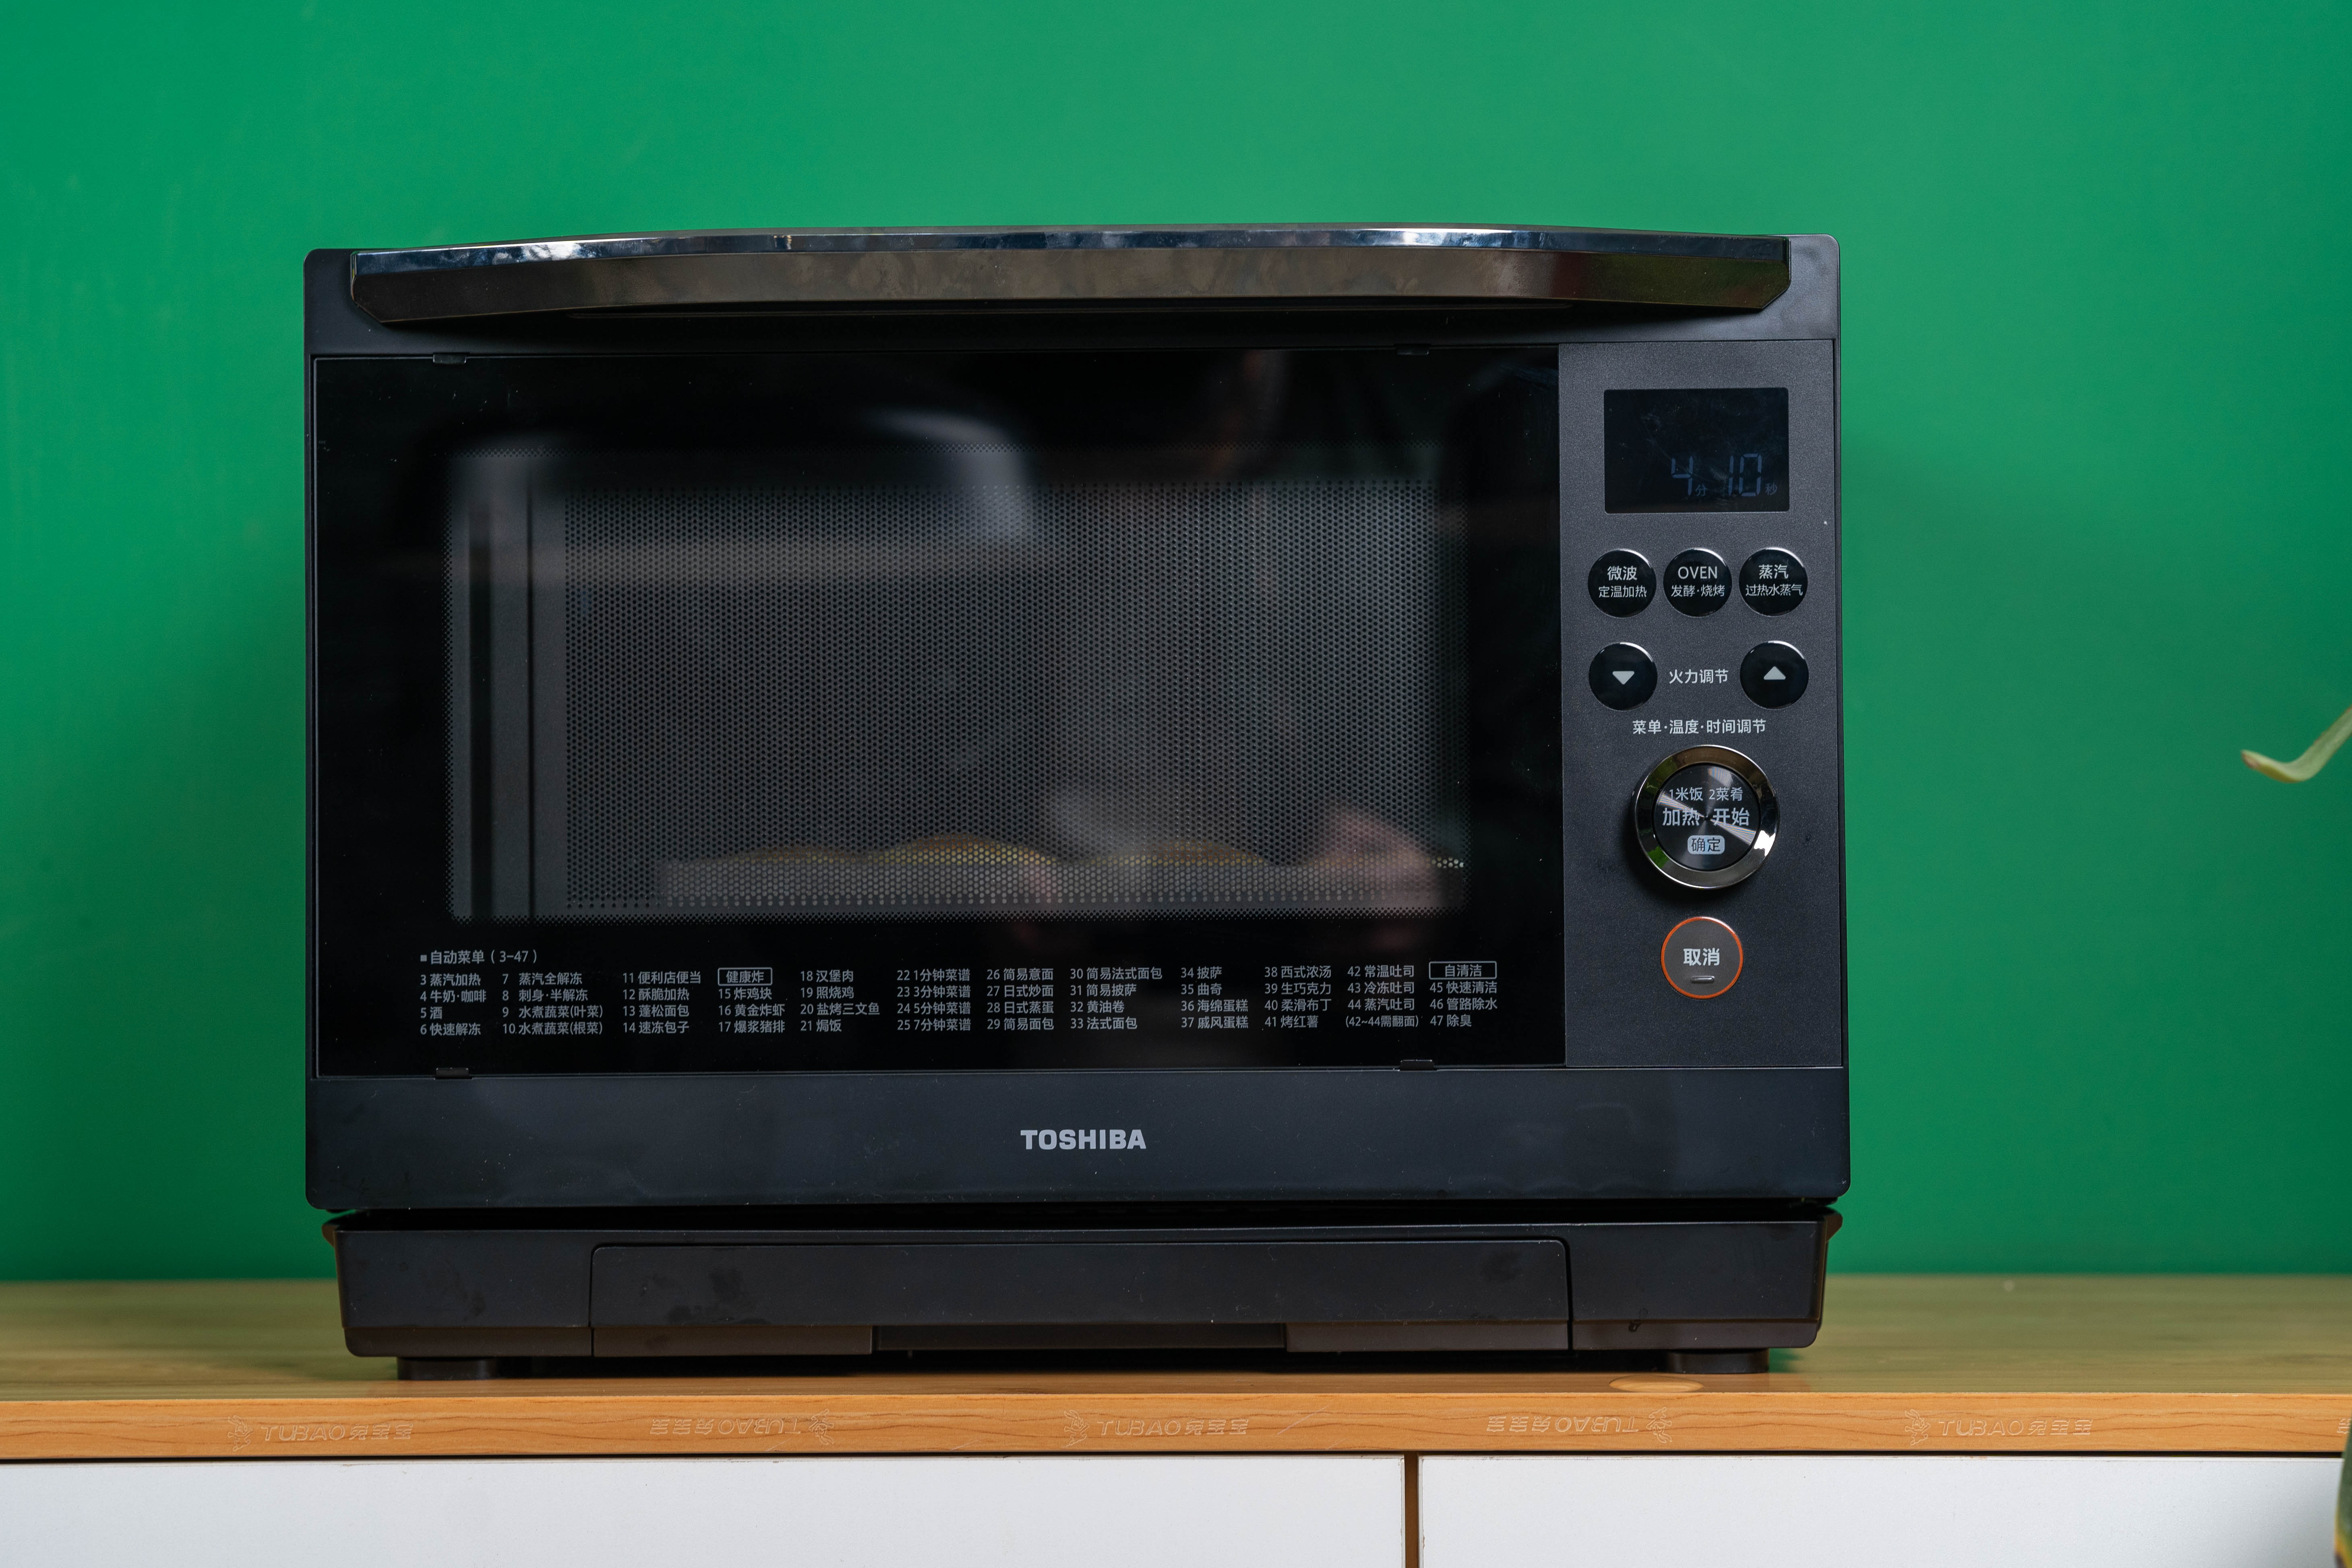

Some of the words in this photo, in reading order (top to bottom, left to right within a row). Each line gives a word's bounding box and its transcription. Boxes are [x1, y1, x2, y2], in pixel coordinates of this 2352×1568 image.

[1607, 566, 1637, 581] 微波
[1678, 566, 1717, 579] OVEN
[1758, 564, 1789, 579] 蒸汽
[1598, 585, 1647, 598] 定温加热
[1746, 583, 1803, 596] 过热水蒸气
[1669, 668, 1729, 684] 火力调节
[1709, 785, 1743, 801] 2菜肴
[1662, 807, 1700, 826] 加热
[1712, 807, 1750, 826] 开始
[1691, 838, 1721, 852] 确定
[431, 949, 485, 964] 自动菜单
[1683, 947, 1720, 966] 取消
[623, 972, 633, 983] 11
[638, 970, 701, 985] 便利店便当
[726, 970, 764, 983] 健康炸
[801, 970, 813, 981] 18
[816, 969, 854, 983] 汉堡肉
[897, 970, 910, 981] 22
[987, 969, 1000, 980] 26
[1003, 967, 1053, 981] 简易意面
[1070, 968, 1083, 979] 30
[1086, 966, 1163, 980] 简易法式面包
[1181, 967, 1194, 978] 34
[1197, 966, 1222, 979] 披萨
[1264, 966, 1278, 977] 38
[1281, 965, 1331, 978] 西式浓汤
[1347, 966, 1361, 976] 42
[1364, 964, 1414, 978] 常温吐司
[1445, 964, 1482, 977] 自清洁
[420, 974, 426, 985] 3
[430, 973, 481, 987] 蒸汽加热
[502, 973, 509, 985] 7
[519, 972, 583, 985] 蒸汽全解冻
[623, 989, 635, 1000] 12
[639, 987, 689, 1001] 酥脆加热
[718, 988, 731, 999] 15
[734, 987, 772, 1000] 炸鸡块
[801, 987, 813, 998] 19
[816, 986, 854, 999] 照烧鸡
[897, 986, 910, 997] 23
[987, 985, 1000, 996] 27
[1004, 984, 1054, 997] 日式炒面
[1070, 985, 1082, 996] 31
[1086, 983, 1137, 997] 简易披萨
[1181, 984, 1194, 995] 35
[1198, 983, 1222, 996] 曲奇
[1264, 983, 1278, 994] 39
[1281, 981, 1331, 995] 生巧克力
[1347, 983, 1361, 993] 43
[1364, 981, 1414, 995] 冷冻吐司
[1429, 982, 1443, 993] 45
[1446, 981, 1498, 994] 快速清洁
[420, 991, 427, 1002] 4
[502, 990, 509, 1001] 8
[623, 1005, 635, 1016] 13
[639, 1003, 689, 1018] 蓬松面包
[718, 1005, 731, 1016] 16
[734, 1003, 785, 1017] 黄金炸虾
[800, 1003, 814, 1014] 20
[817, 1002, 880, 1016] 盐烤三文鱼
[897, 1003, 910, 1014] 24
[987, 1002, 1000, 1013] 28
[1004, 1001, 1054, 1014] 日式蒸蛋
[1070, 1001, 1084, 1012] 32
[1087, 1000, 1125, 1013] 黄油卷
[1181, 1000, 1194, 1011] 36
[1197, 999, 1248, 1012] 海绵蛋糕
[1264, 999, 1278, 1011] 40
[1281, 998, 1332, 1012] 柔滑布丁
[1347, 999, 1361, 1010] 44
[1364, 997, 1415, 1011] 蒸汽吐司
[1429, 998, 1444, 1009] 46
[1446, 997, 1498, 1011] 管路除水
[420, 1007, 427, 1018] 5
[430, 1006, 443, 1020] 酒
[502, 1006, 509, 1018] 9
[623, 1022, 636, 1033] 14
[639, 1020, 689, 1034] 速冻包子
[719, 1021, 731, 1032] 17
[734, 1020, 785, 1033] 爆浆猪排
[800, 1020, 812, 1031] 21
[816, 1019, 842, 1032] 焗饭
[897, 1020, 910, 1030] 25
[987, 1018, 1000, 1030] 29
[1003, 1017, 1054, 1030] 简易面包
[1070, 1018, 1084, 1029] 33
[1087, 1016, 1138, 1030] 法式面包
[1181, 1017, 1194, 1028] 37
[1198, 1015, 1248, 1029] 戚风蛋糕
[1264, 1016, 1276, 1027] 41
[1280, 1015, 1319, 1028] 烤红薯
[1430, 1015, 1444, 1026] 47
[1446, 1014, 1472, 1027] 除臭
[420, 1024, 427, 1035] 6
[429, 1022, 481, 1036] 快速解冻
[503, 1023, 515, 1034] 10
[1020, 1129, 1146, 1150] TOSHIBA
[718, 1417, 801, 1434] TUBAO
[1097, 1420, 1181, 1436] TUBAO
[1555, 1416, 1638, 1432] TUBAO
[1938, 1420, 2024, 1436] TUBAO
[261, 1425, 345, 1441] TUBAO
